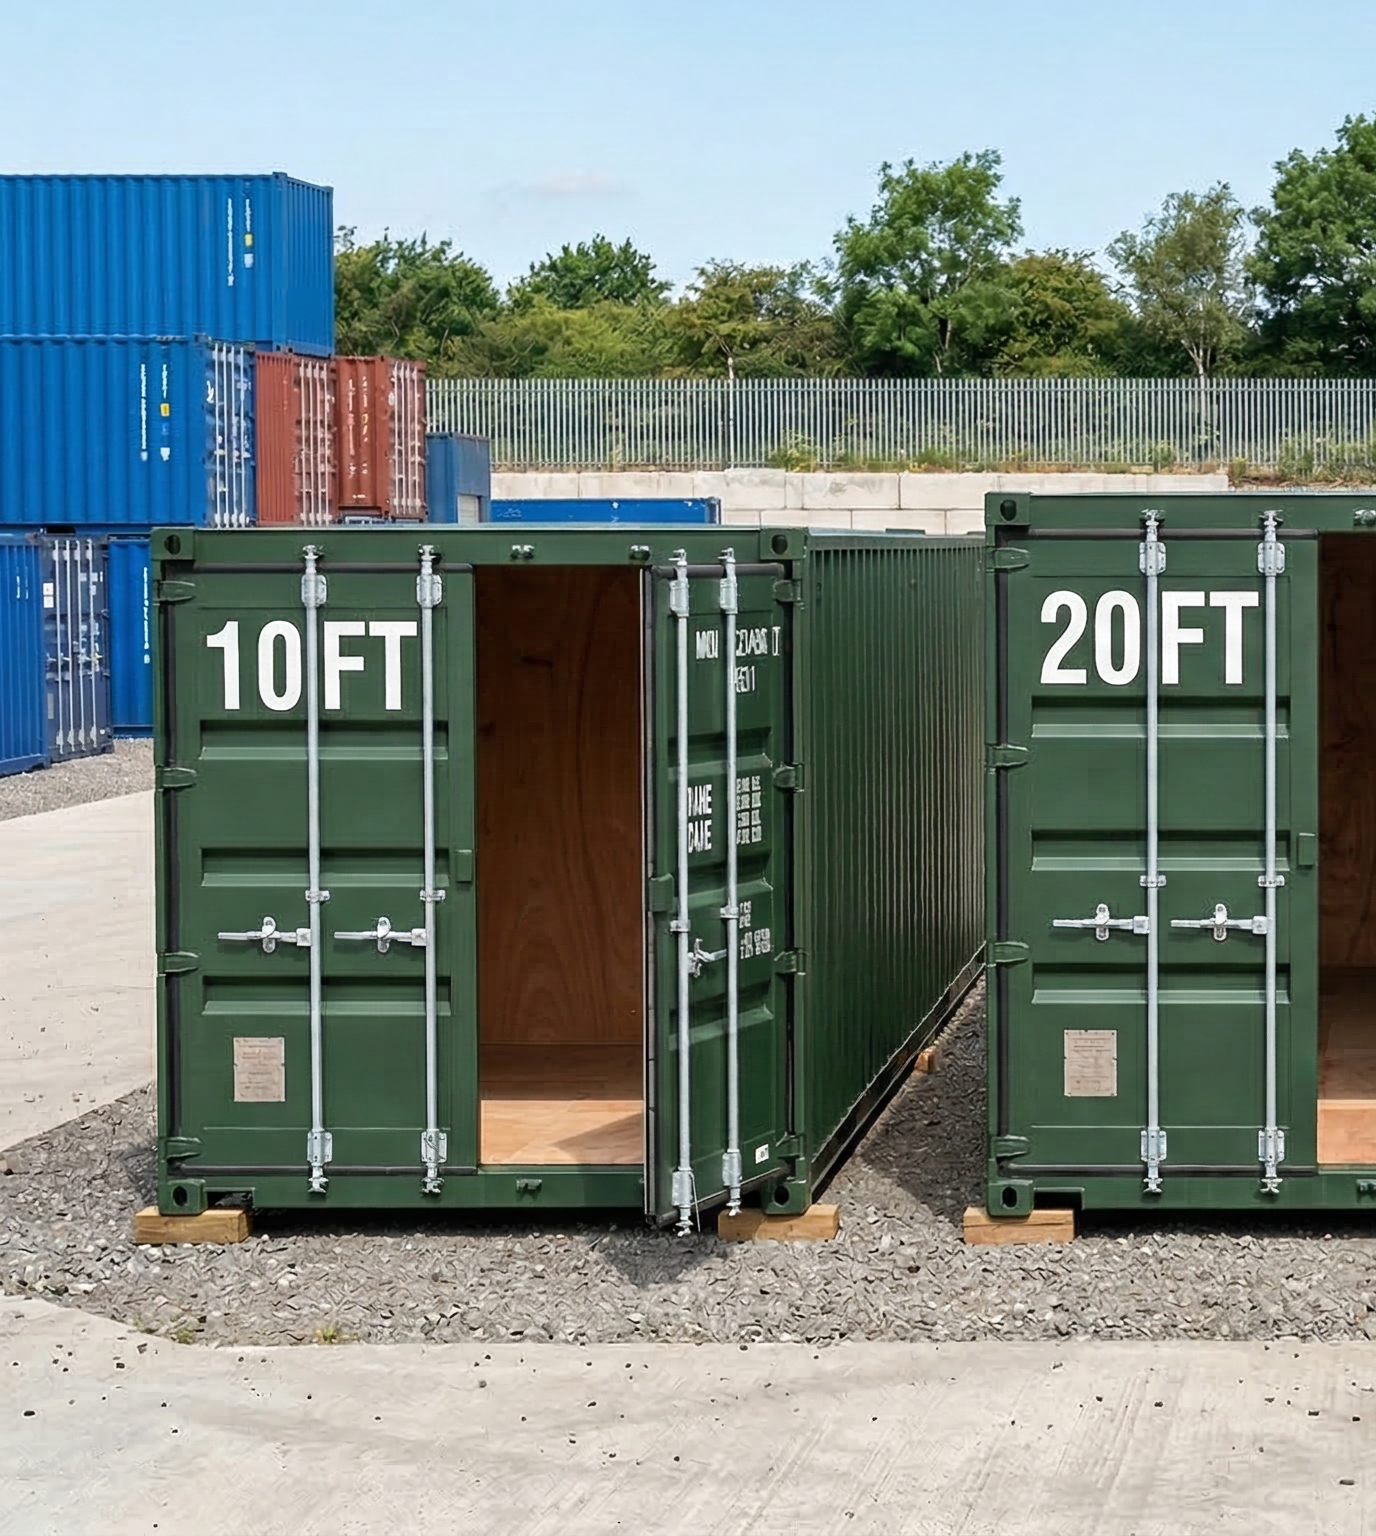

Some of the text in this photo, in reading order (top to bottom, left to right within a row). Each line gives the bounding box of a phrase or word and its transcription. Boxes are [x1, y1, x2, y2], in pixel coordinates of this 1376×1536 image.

[206, 620, 418, 711] 10 FT
[1040, 589, 1259, 685] 20 FT
